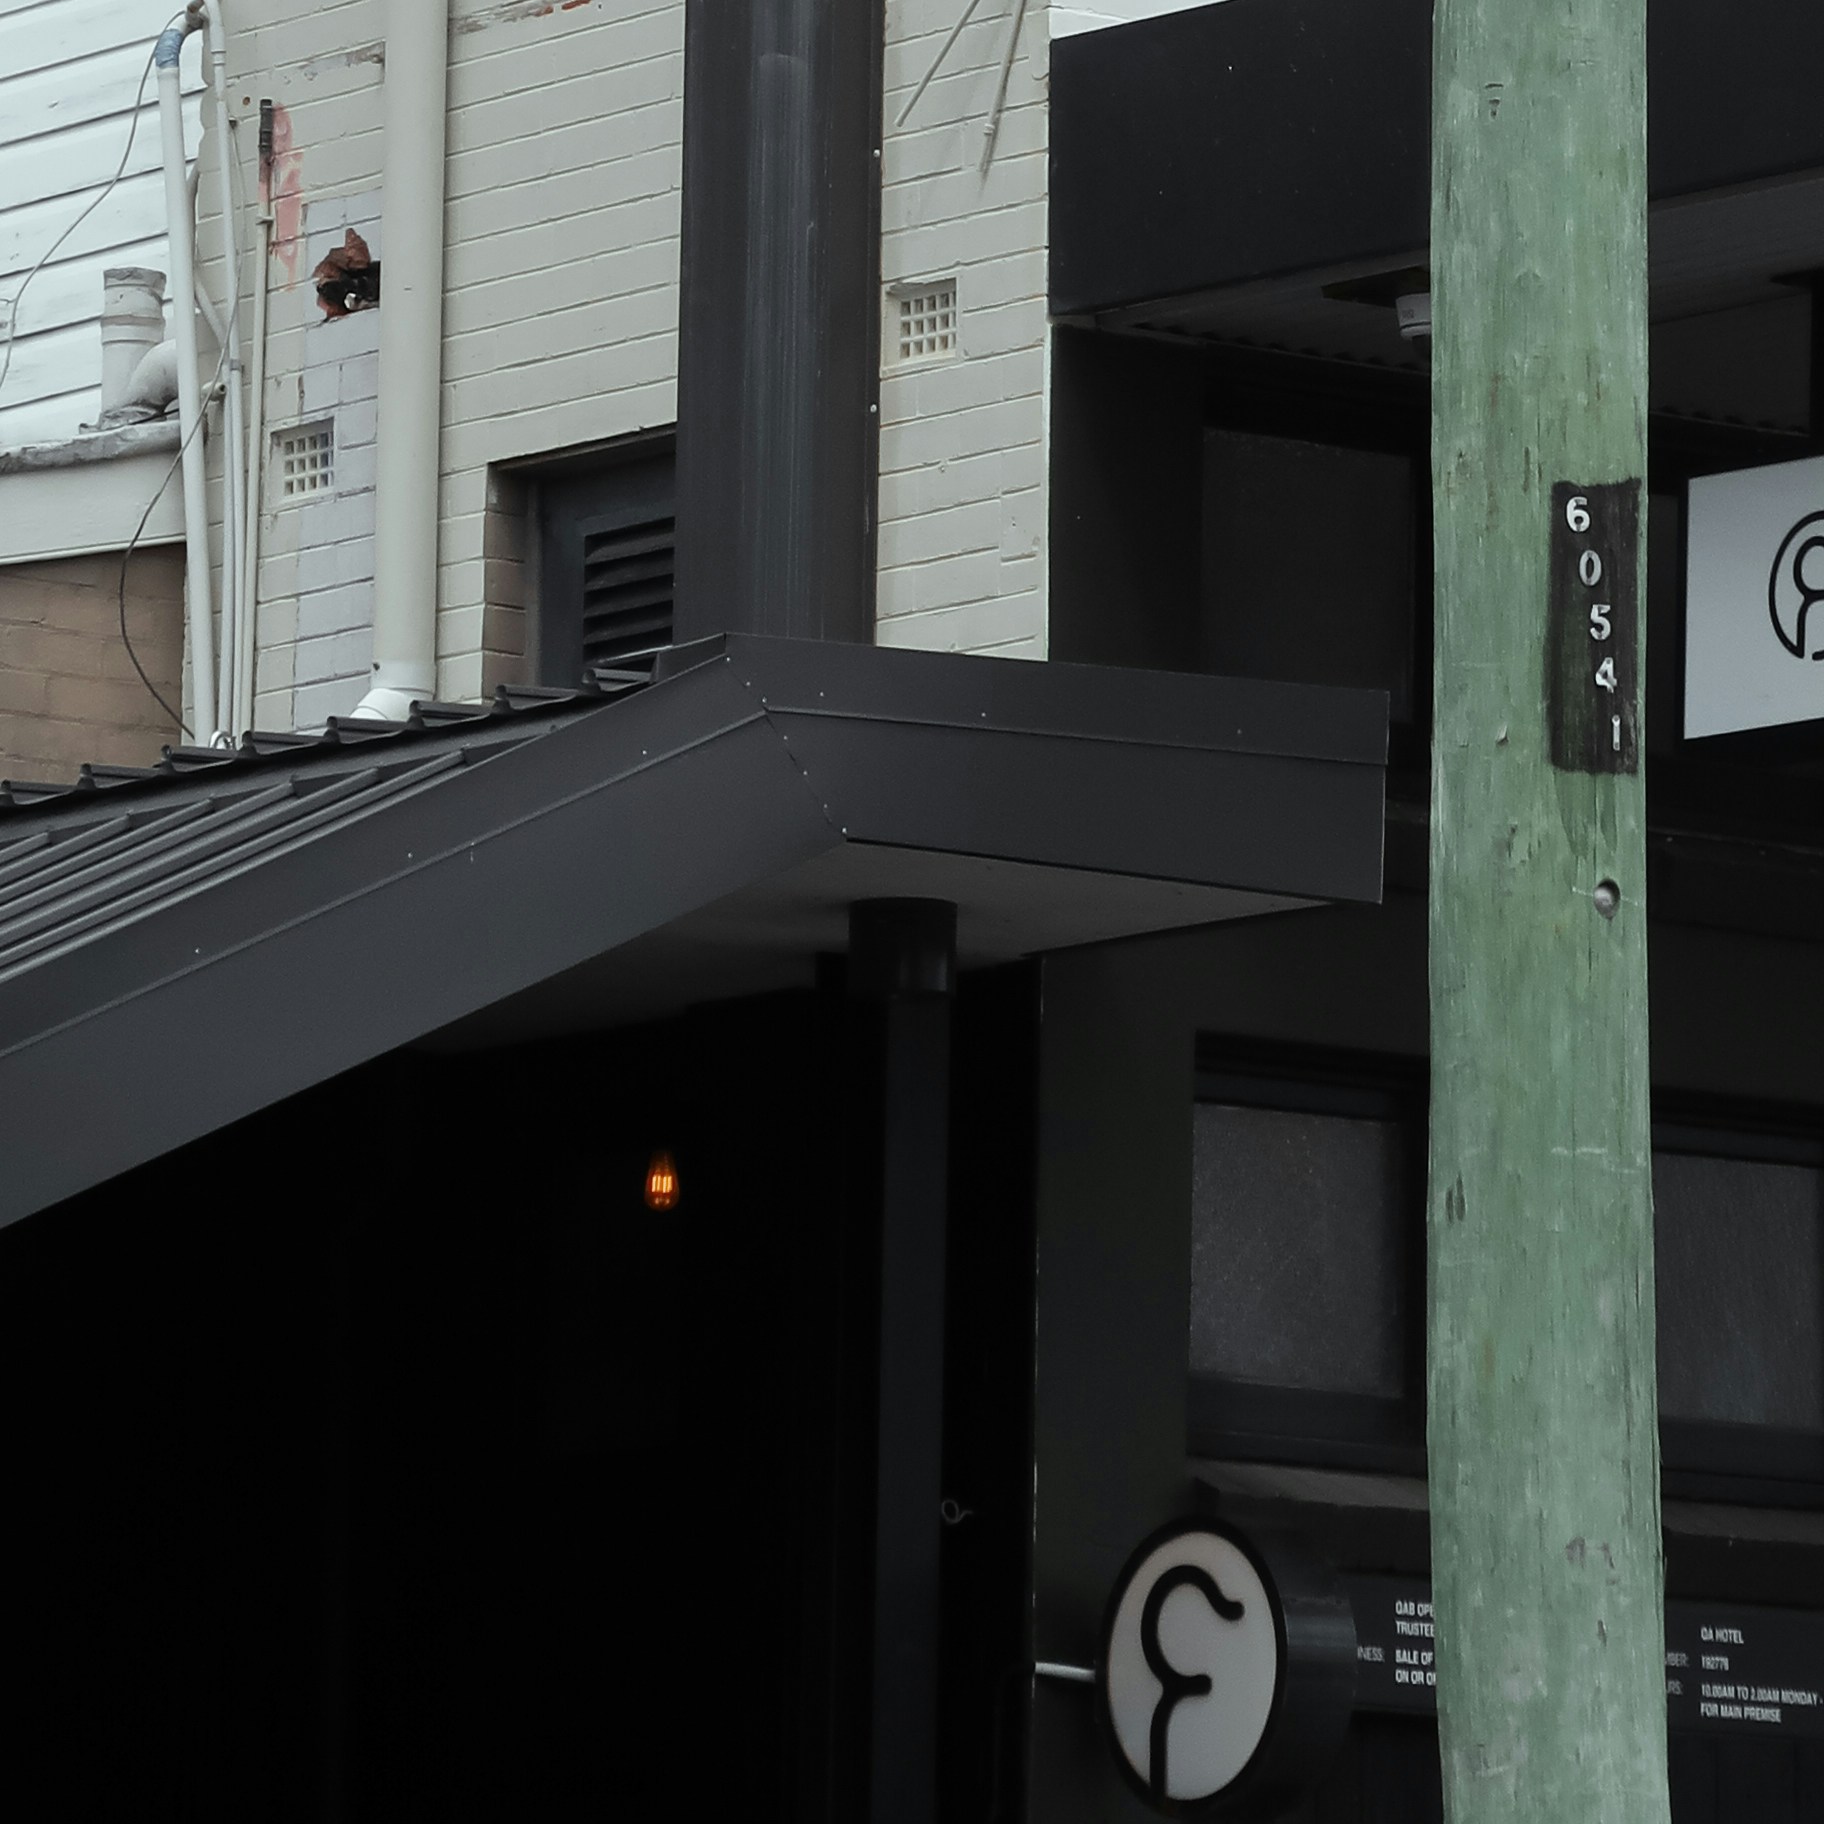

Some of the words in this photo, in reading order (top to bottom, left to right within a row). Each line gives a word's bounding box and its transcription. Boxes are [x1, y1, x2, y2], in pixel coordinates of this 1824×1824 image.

[1565, 496, 1621, 751] 60541
[1715, 1628, 1744, 1644] HOTEL
[1737, 1686, 1749, 1701] TO
[1781, 1689, 1818, 1706] MONDAY
[1701, 1702, 1718, 1717] FOR
[1720, 1704, 1742, 1719] MAIN
[1744, 1706, 1781, 1723] PREMISE
